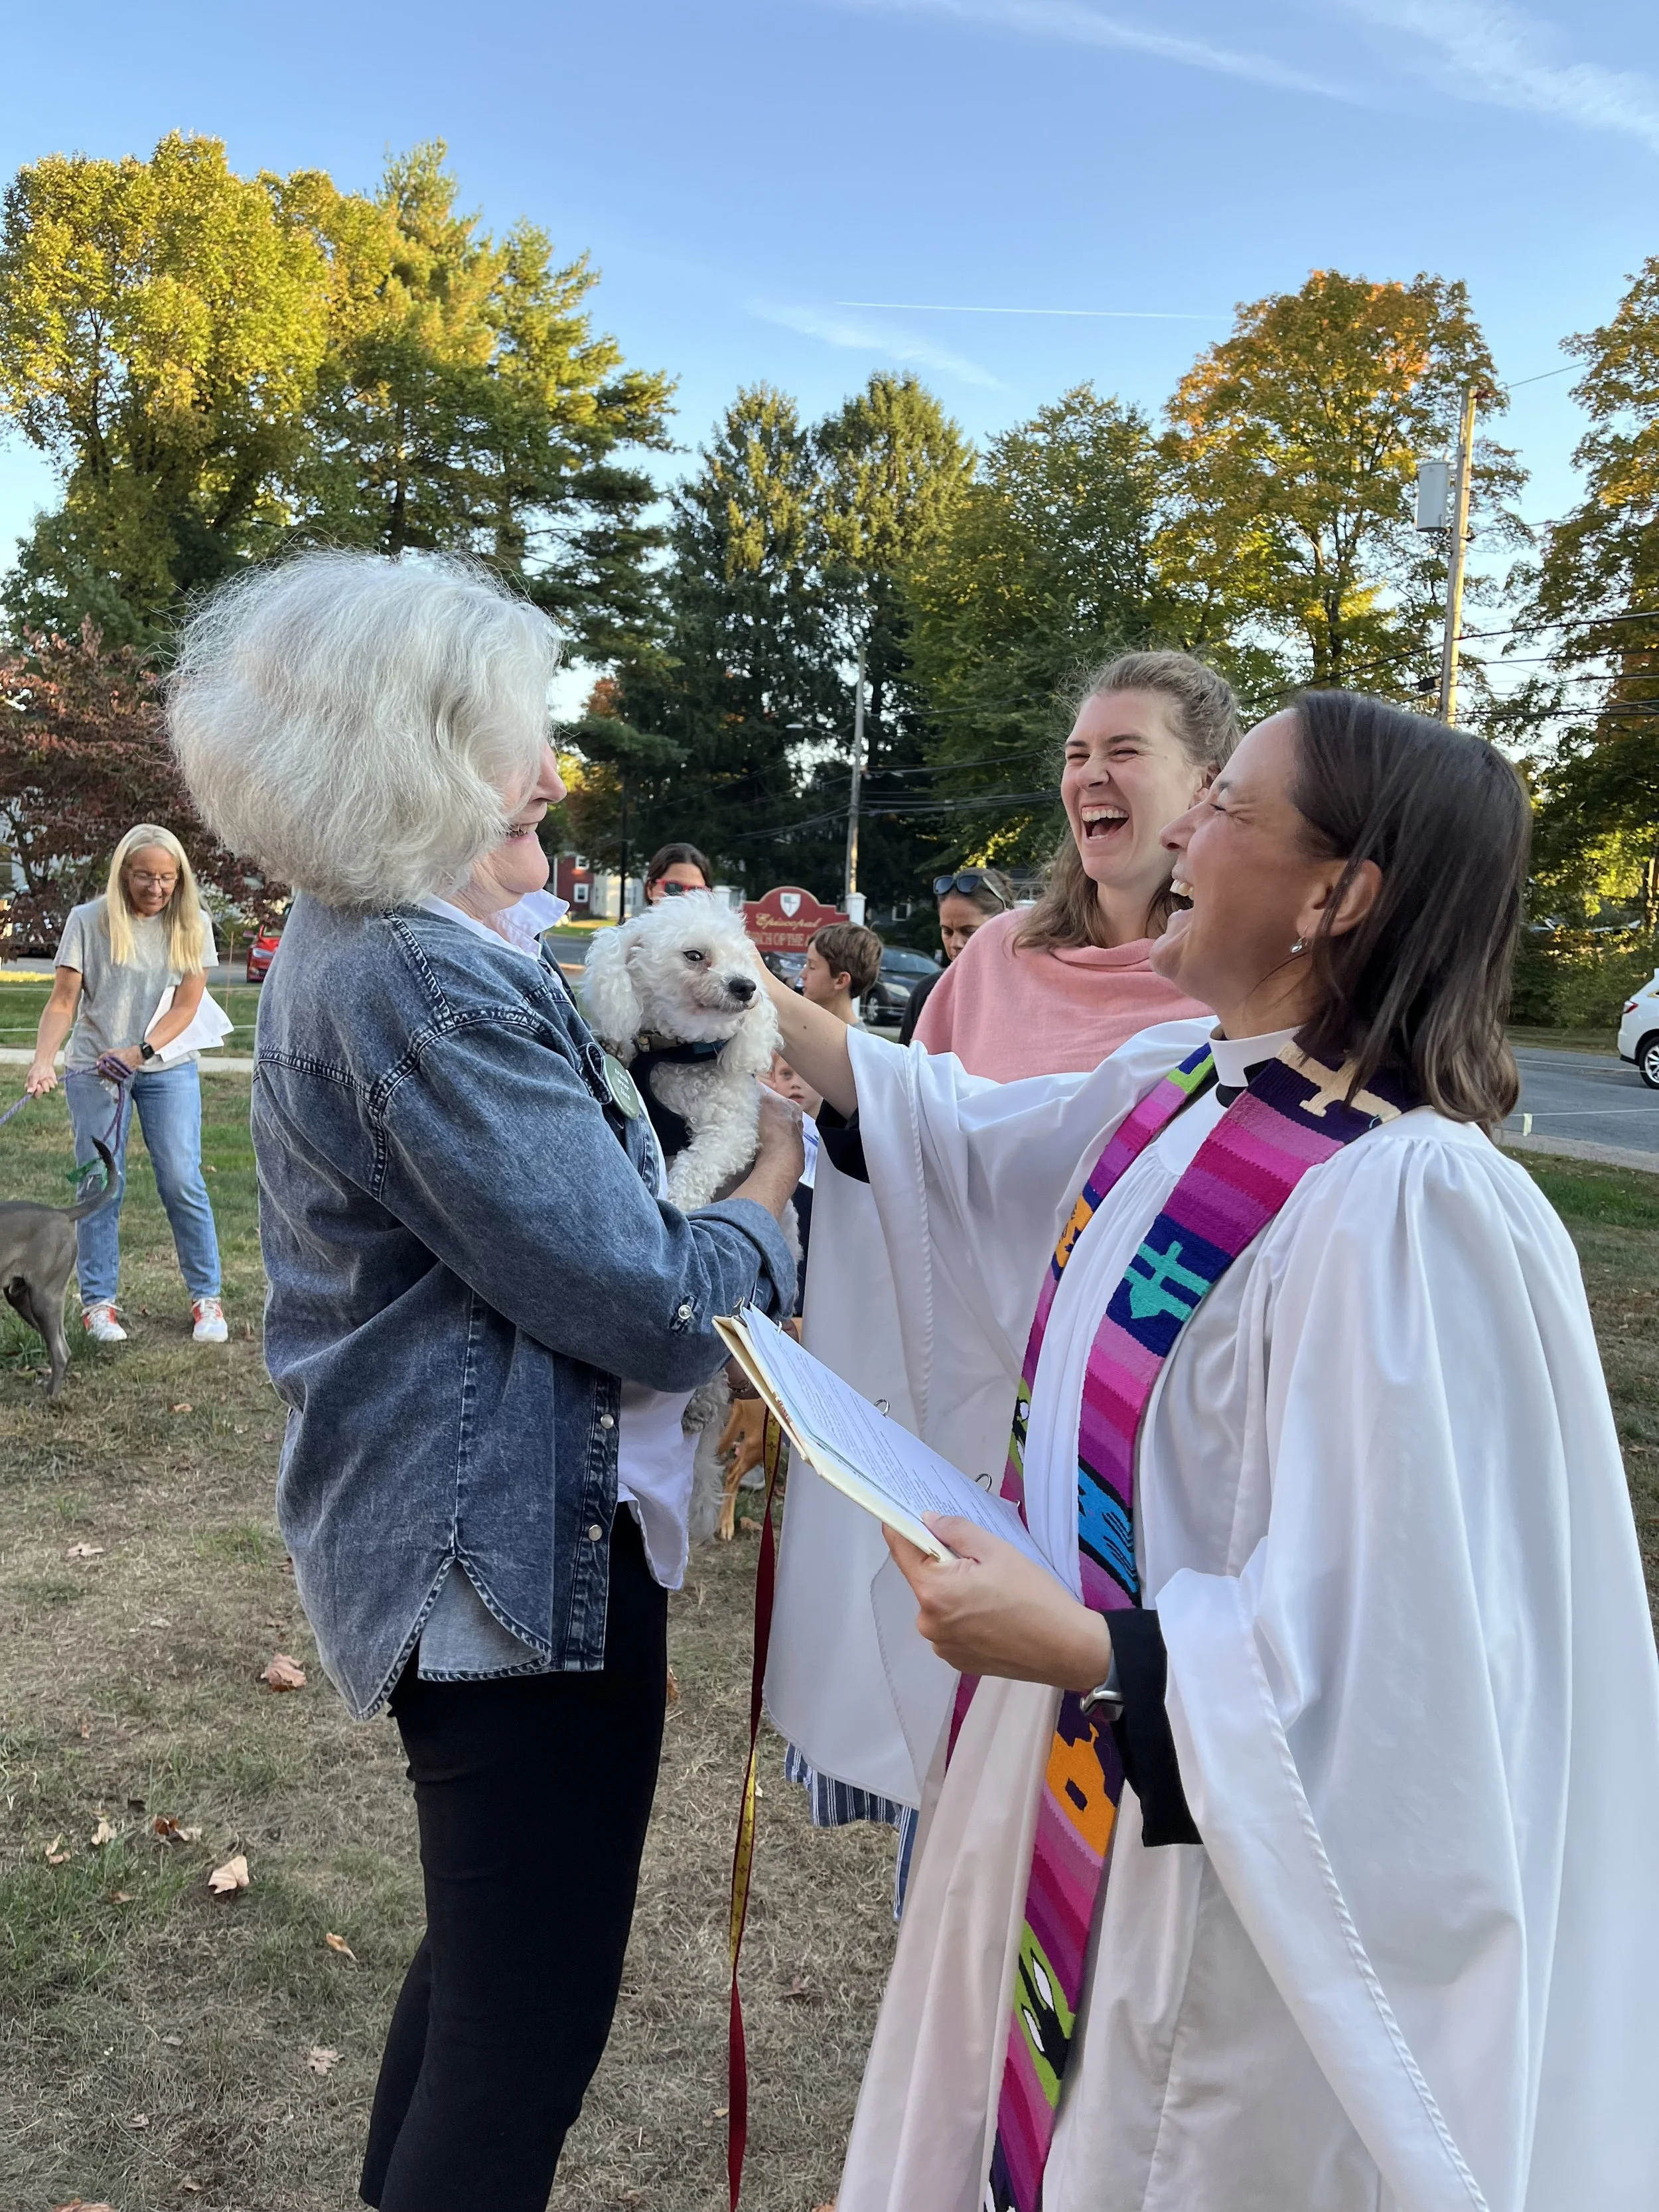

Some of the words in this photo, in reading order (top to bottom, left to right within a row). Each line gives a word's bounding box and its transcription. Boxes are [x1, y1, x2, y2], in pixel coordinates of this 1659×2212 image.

[756, 913, 822, 930] Episcopal
[773, 932, 786, 946] OF
[787, 933, 804, 946] THE
